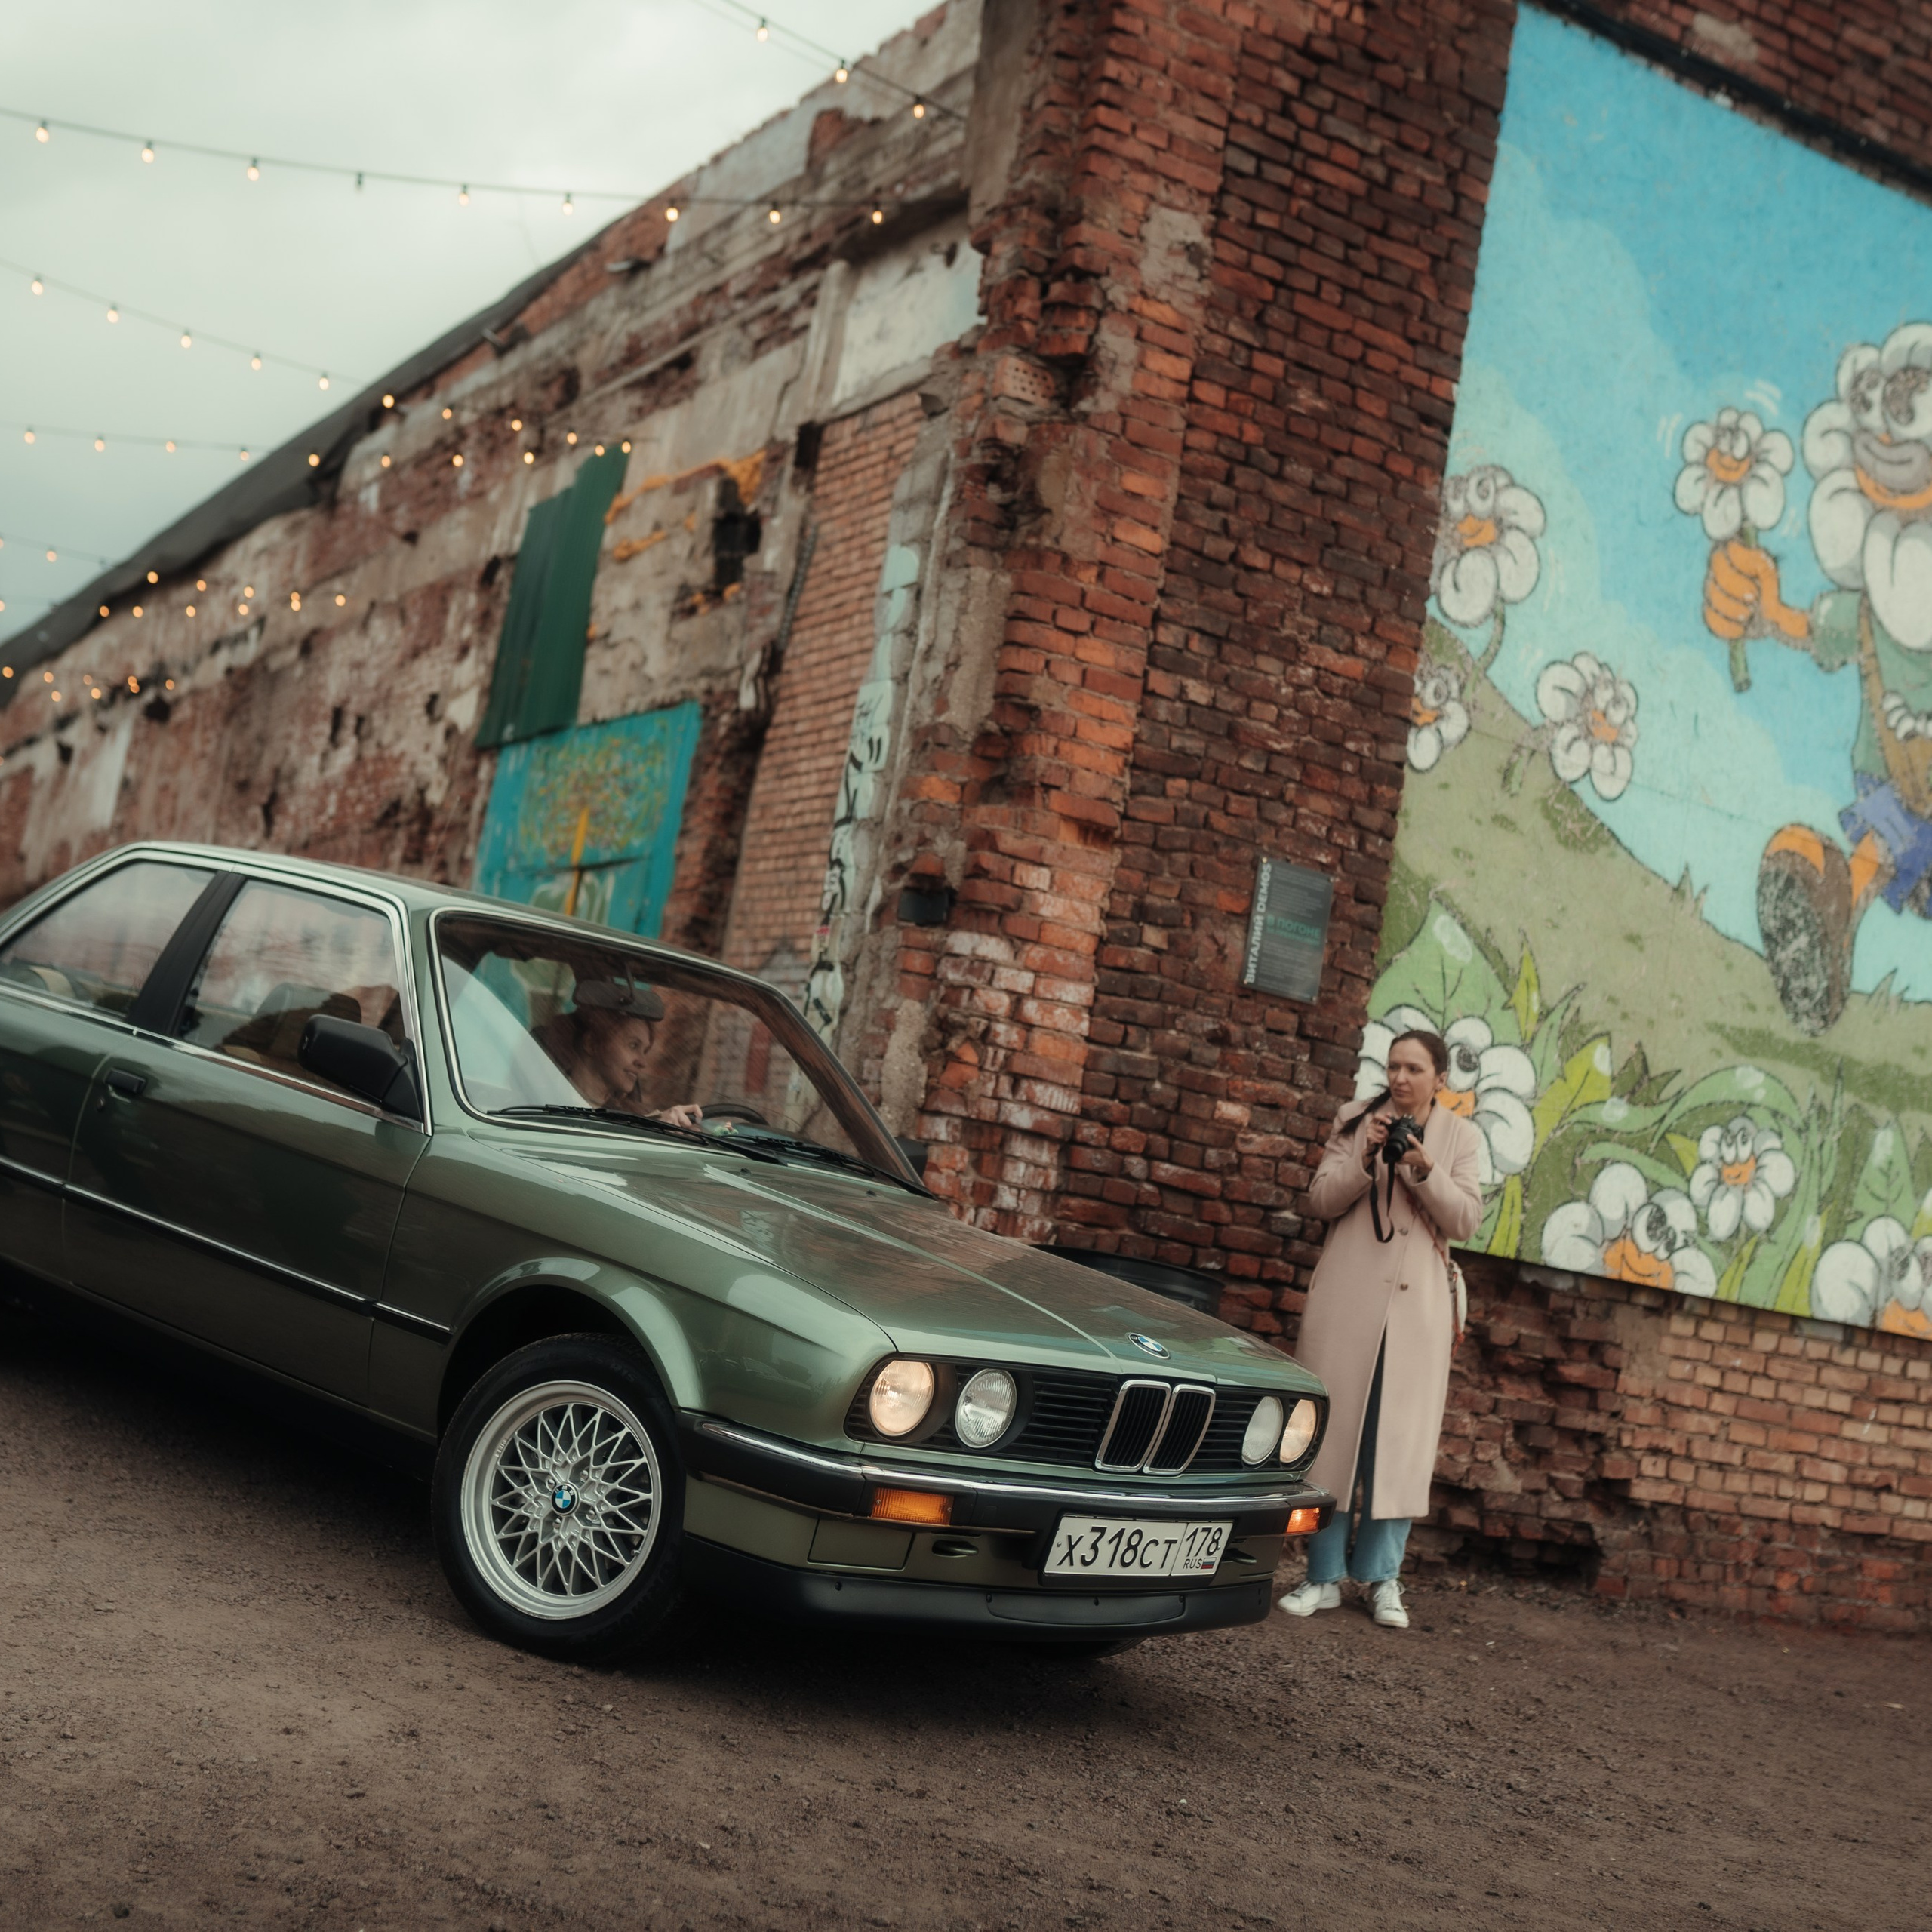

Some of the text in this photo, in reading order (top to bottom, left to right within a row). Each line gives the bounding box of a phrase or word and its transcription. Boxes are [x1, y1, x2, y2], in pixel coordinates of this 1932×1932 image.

[1246, 863, 1272, 983] ВИТАЛИЙ DEMOS
[1277, 917, 1321, 937] ПОГОНЕ
[1186, 1527, 1223, 1557] 178
[1183, 1558, 1202, 1569] RUS
